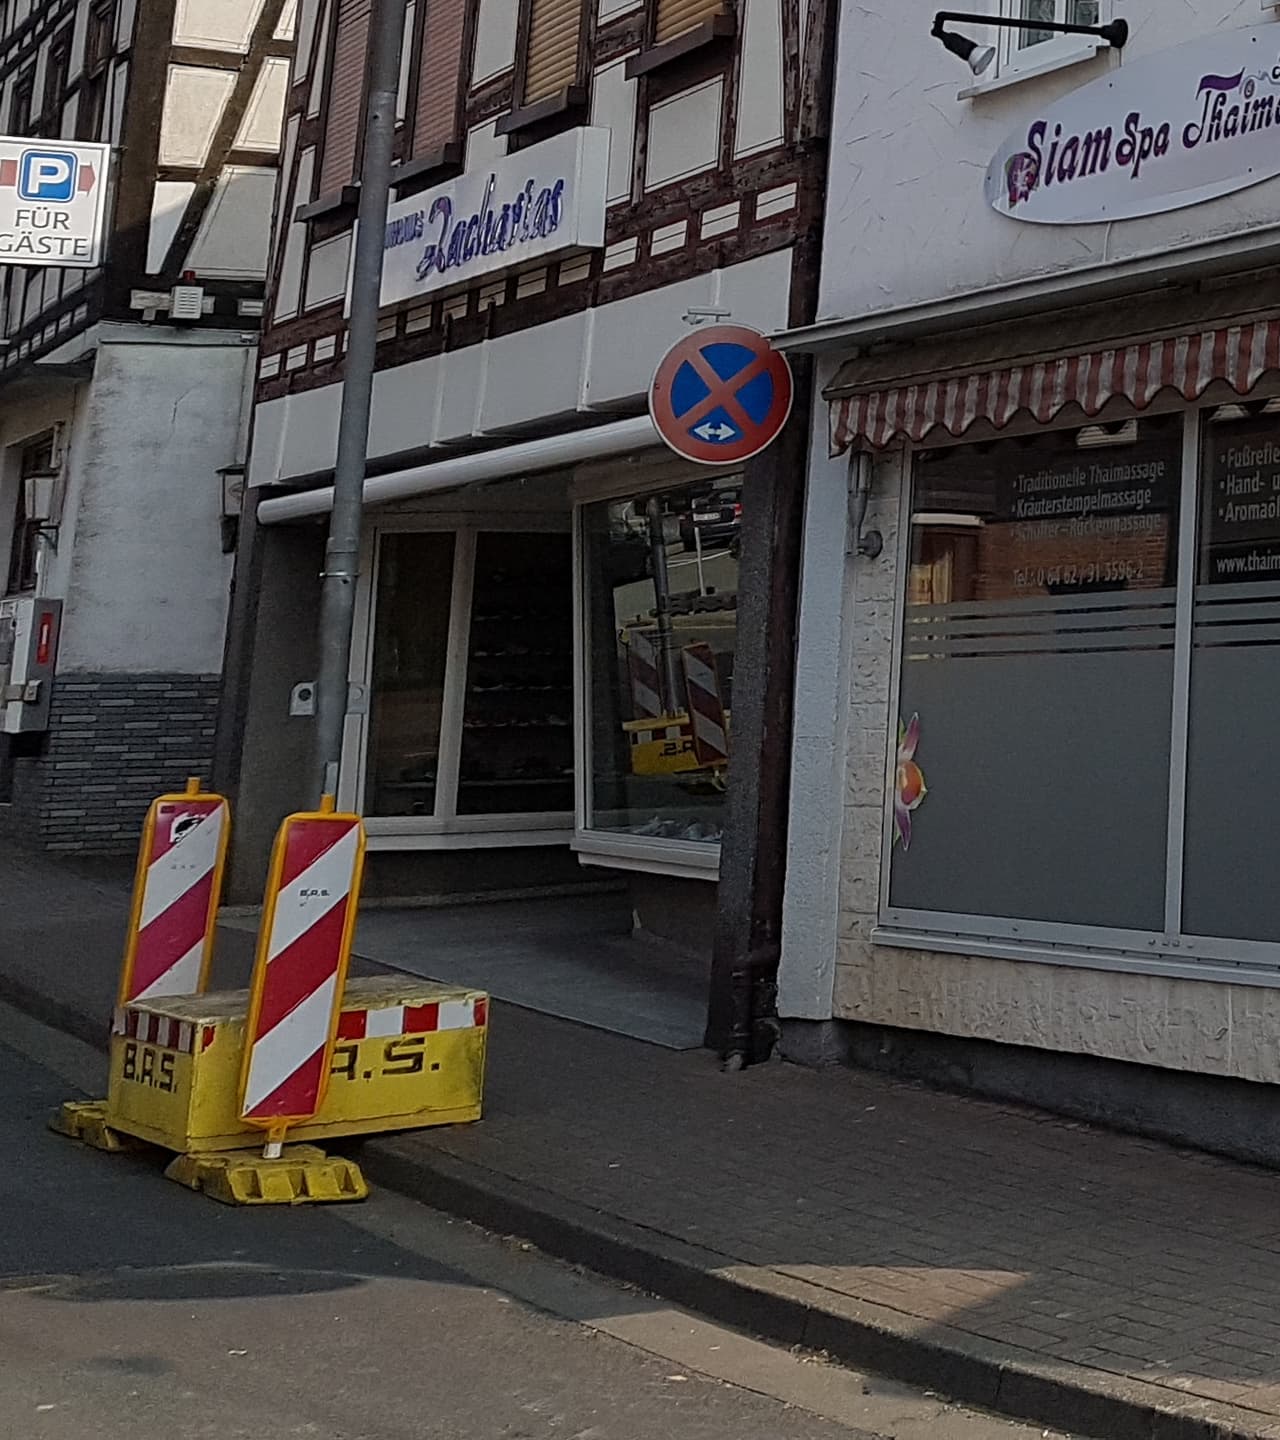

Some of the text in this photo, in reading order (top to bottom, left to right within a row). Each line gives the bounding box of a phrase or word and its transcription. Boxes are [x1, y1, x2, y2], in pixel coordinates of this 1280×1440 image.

[1008, 120, 1113, 197] Siam
[1114, 111, 1171, 180] Spa
[26, 156, 70, 195] P
[14, 206, 71, 231] FÜR
[0, 230, 89, 257] GÄSTE
[1018, 461, 1166, 494] Traditionelle Thaimassage
[1225, 471, 1266, 497] Hand-
[122, 1042, 178, 1094] B.A.S.
[330, 1037, 441, 1082] A.S.
